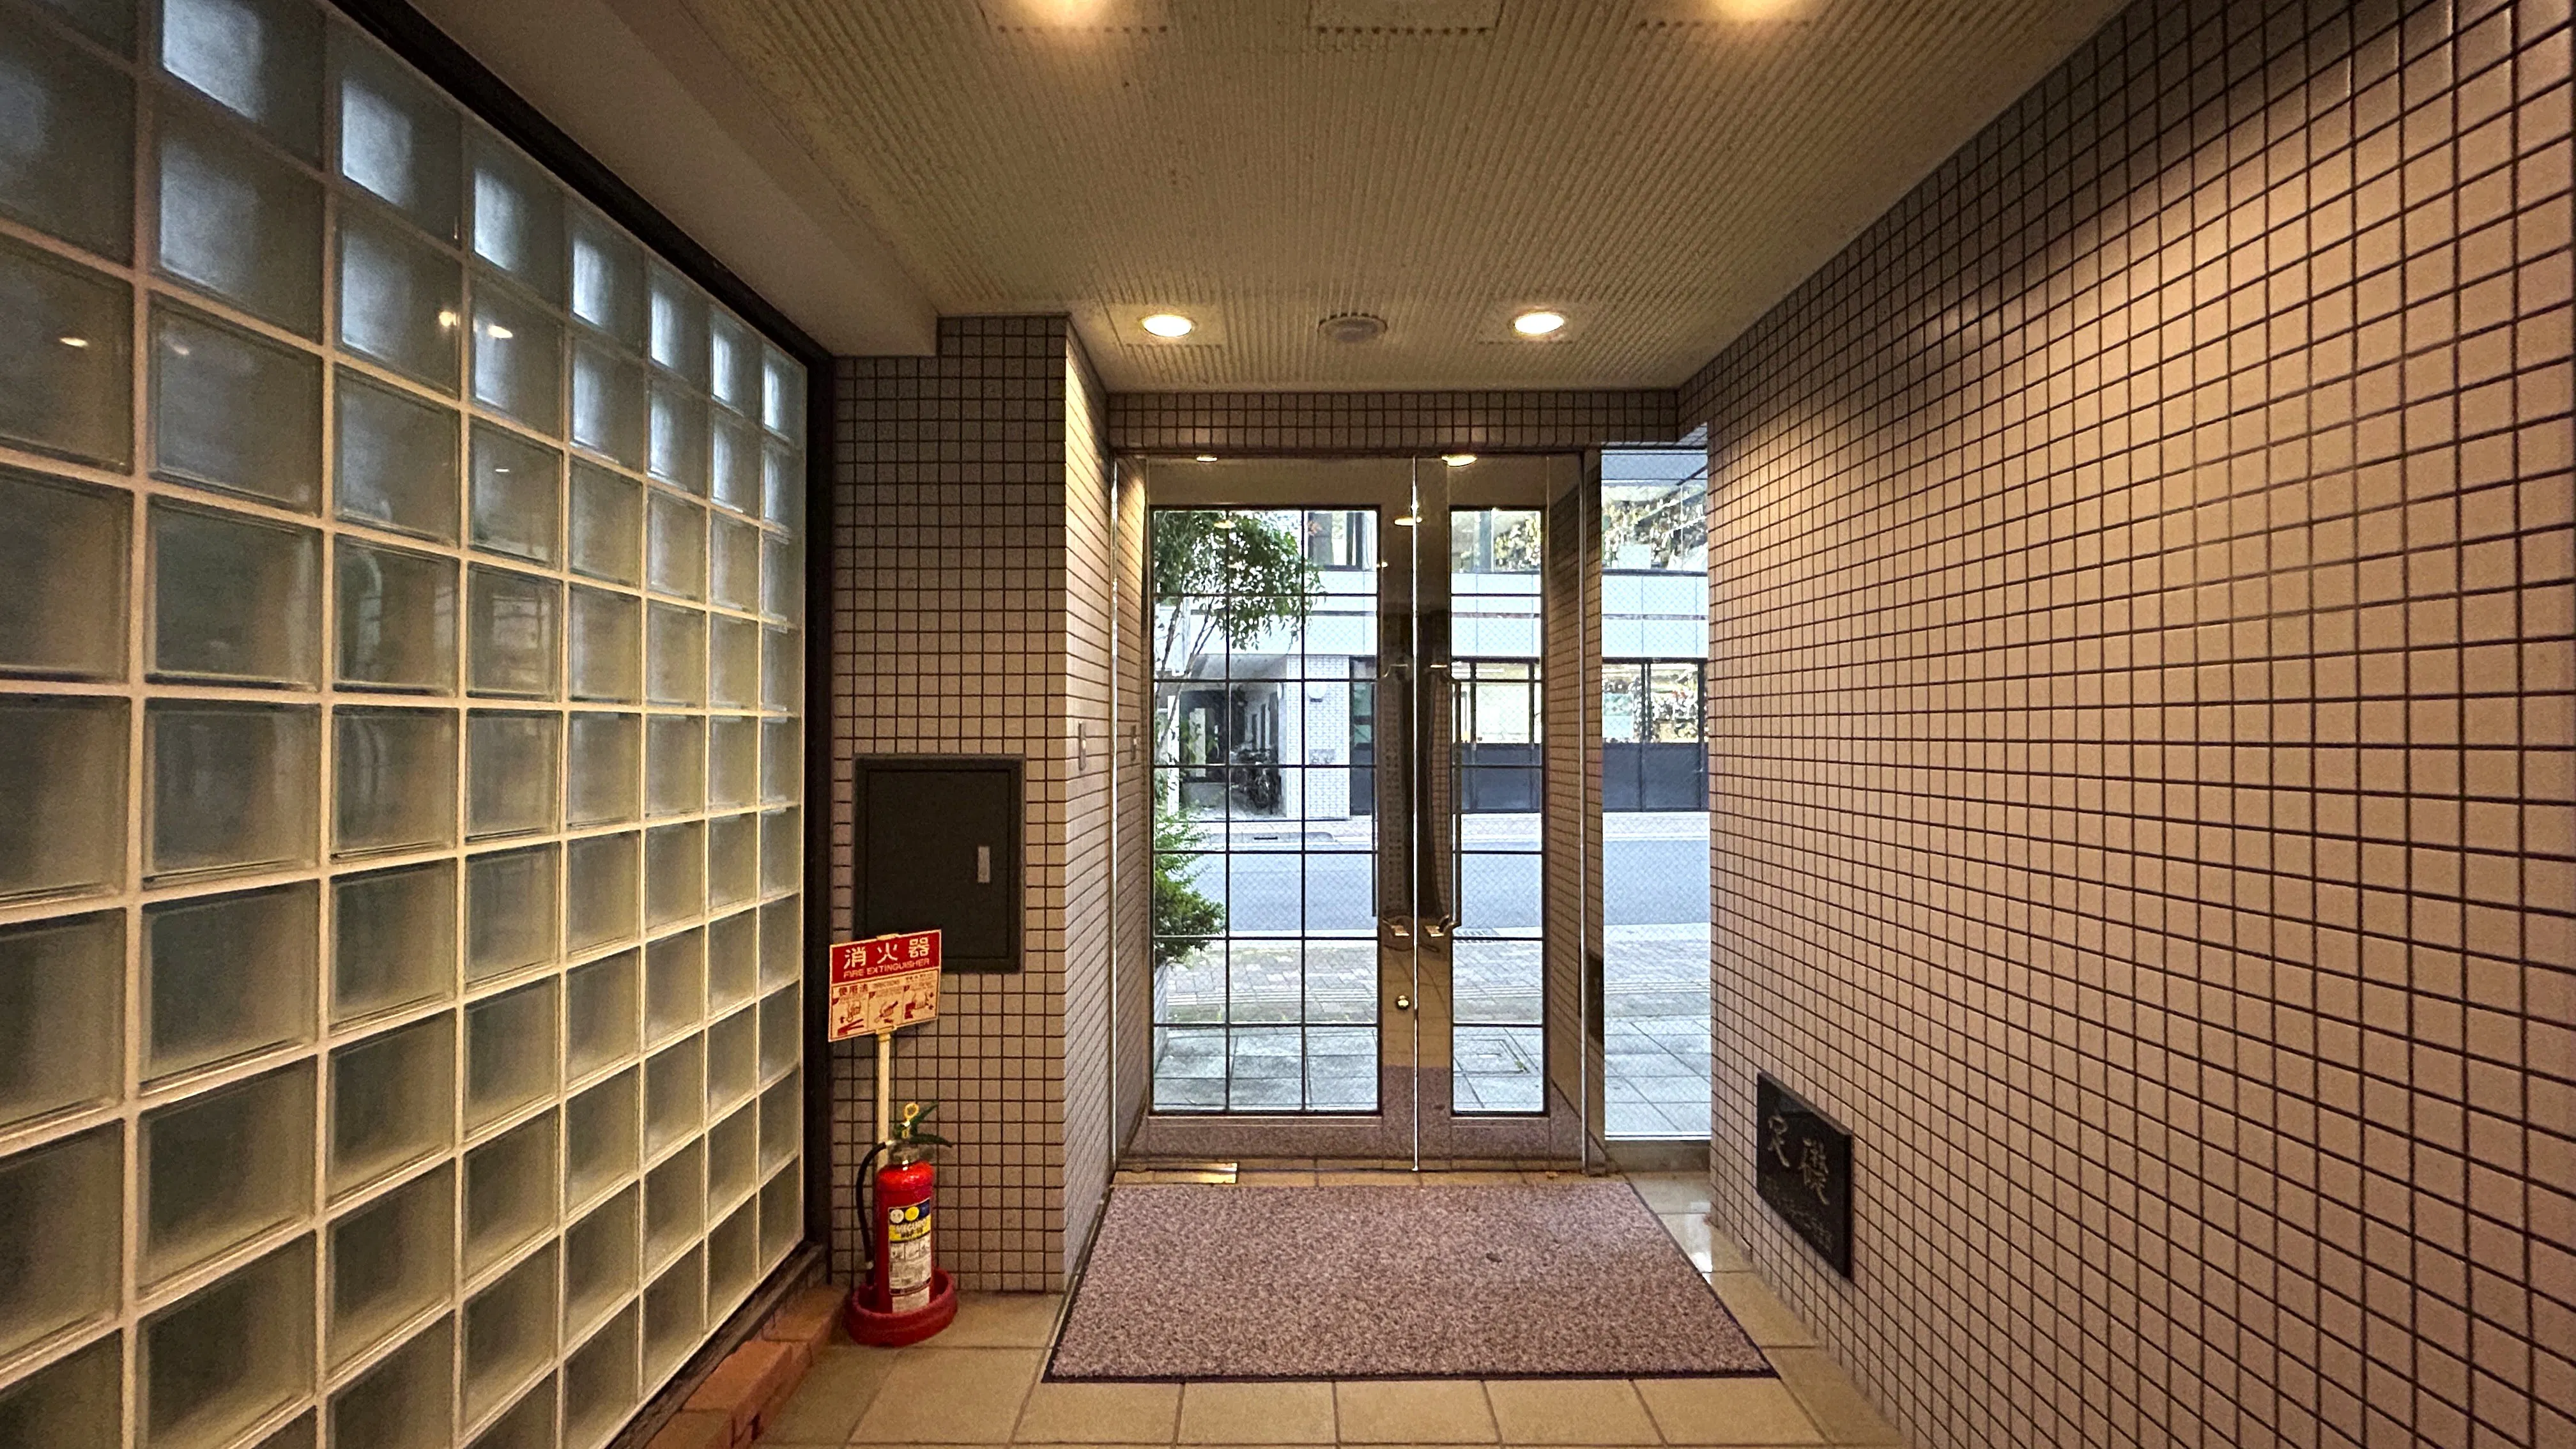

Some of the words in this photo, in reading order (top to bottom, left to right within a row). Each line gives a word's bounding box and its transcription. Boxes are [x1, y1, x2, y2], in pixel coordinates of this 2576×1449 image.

[843, 937, 930, 969] 消火器
[843, 969, 864, 979] FIRE
[866, 958, 930, 975] EXTINGUISHER
[1767, 1109, 1830, 1205] 定礎
